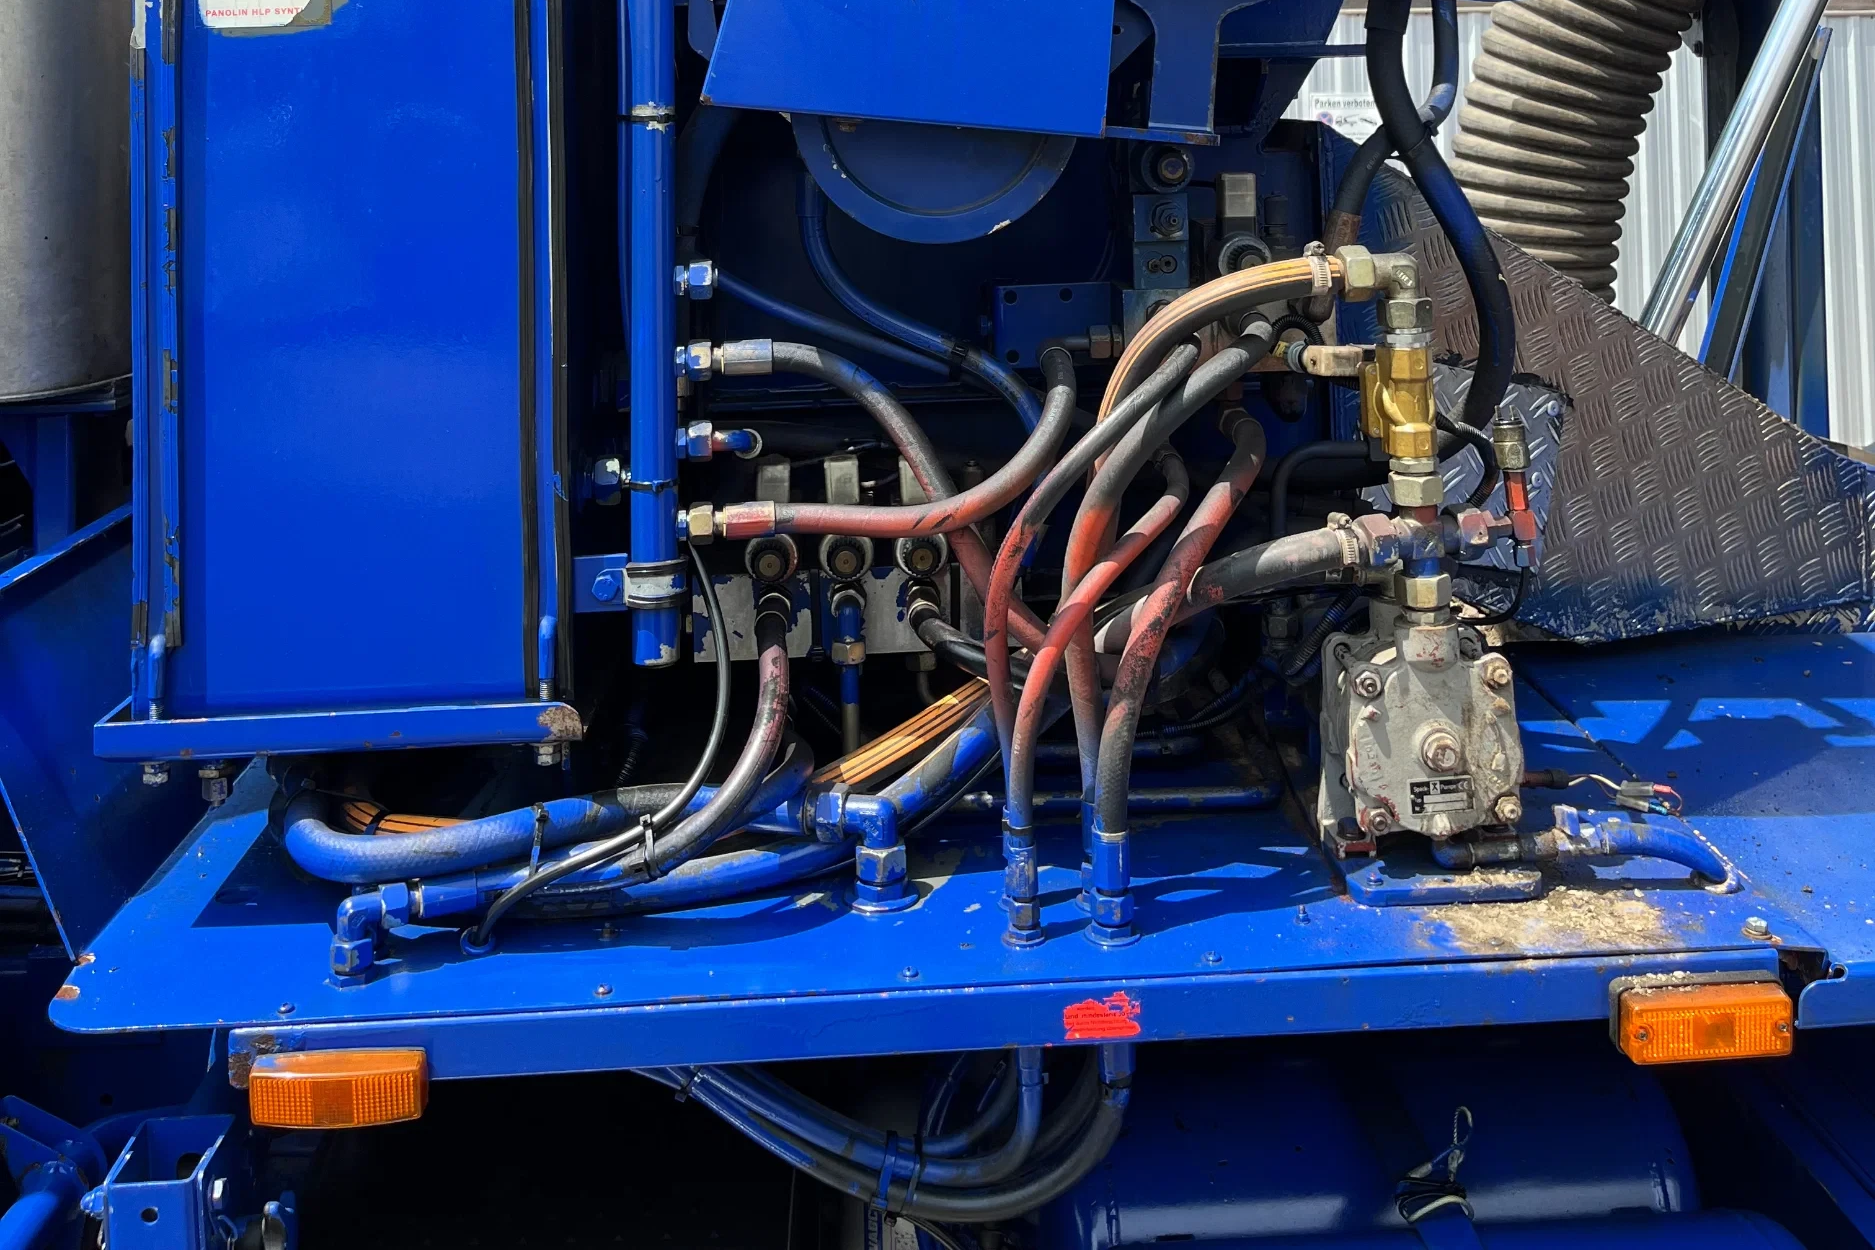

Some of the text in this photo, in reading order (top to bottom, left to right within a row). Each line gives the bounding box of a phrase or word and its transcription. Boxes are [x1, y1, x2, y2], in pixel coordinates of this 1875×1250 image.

[205, 7, 304, 17] PANOLIN HLP SYNT
[1314, 99, 1341, 109] Parken
